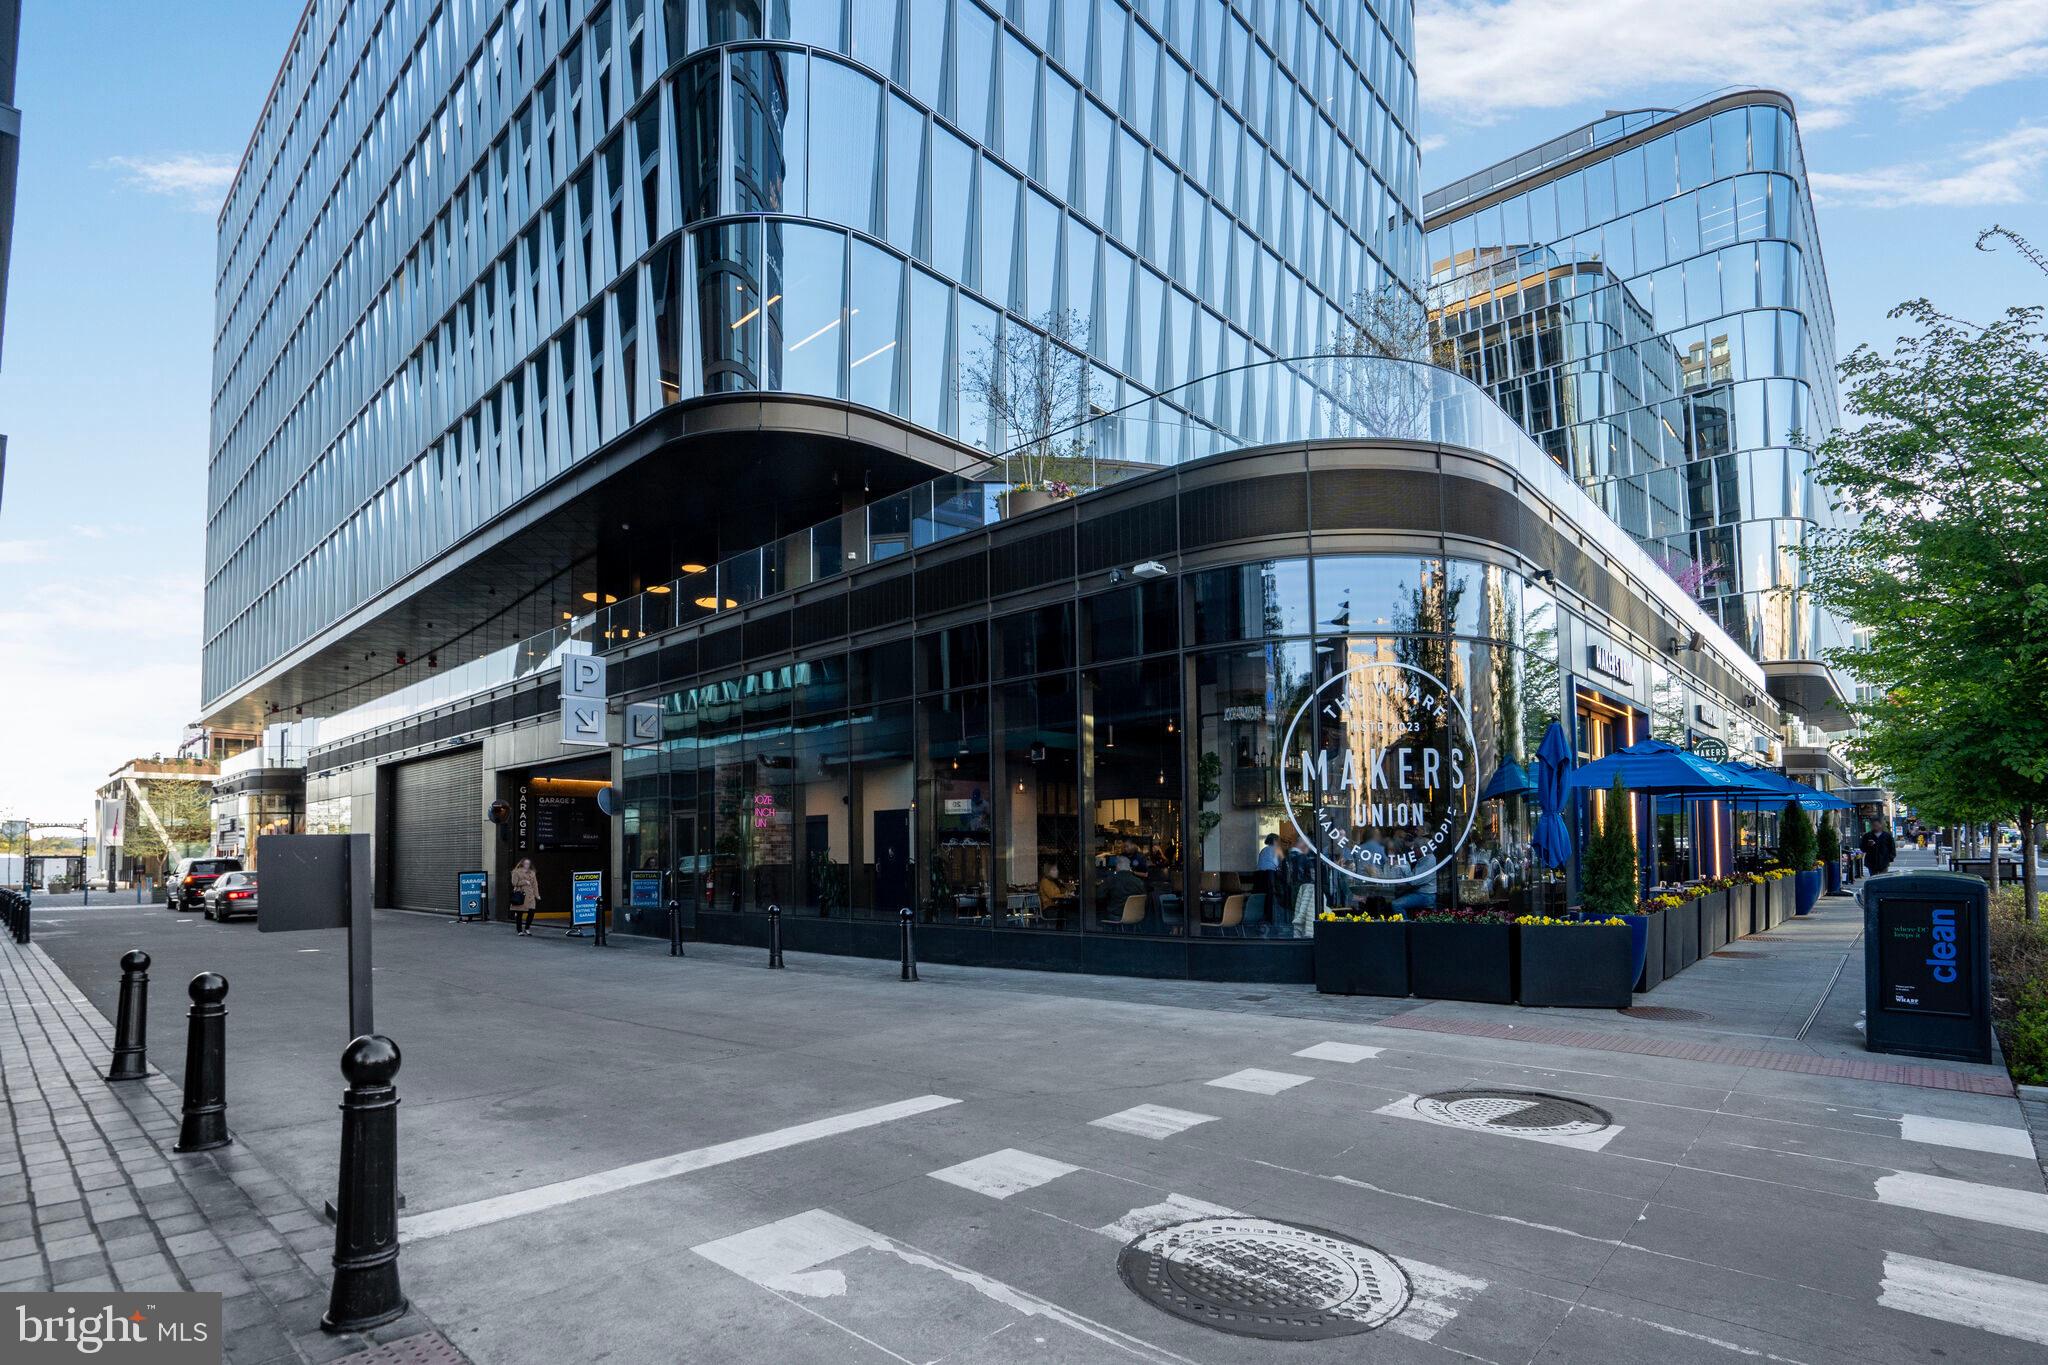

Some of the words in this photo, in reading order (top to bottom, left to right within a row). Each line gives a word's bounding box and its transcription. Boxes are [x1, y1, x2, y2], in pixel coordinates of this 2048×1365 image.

[574, 659, 600, 692] P
[1373, 681, 1447, 717] WHARF
[1391, 722, 1420, 732] 2023
[1302, 748, 1464, 791] MAKERS
[1693, 748, 1726, 757] MAKERS
[1355, 803, 1424, 828] UNION
[1314, 807, 1350, 849] MADE
[1350, 844, 1382, 865] FOR
[1388, 850, 1417, 866] THE
[1926, 909, 1957, 983] clean
